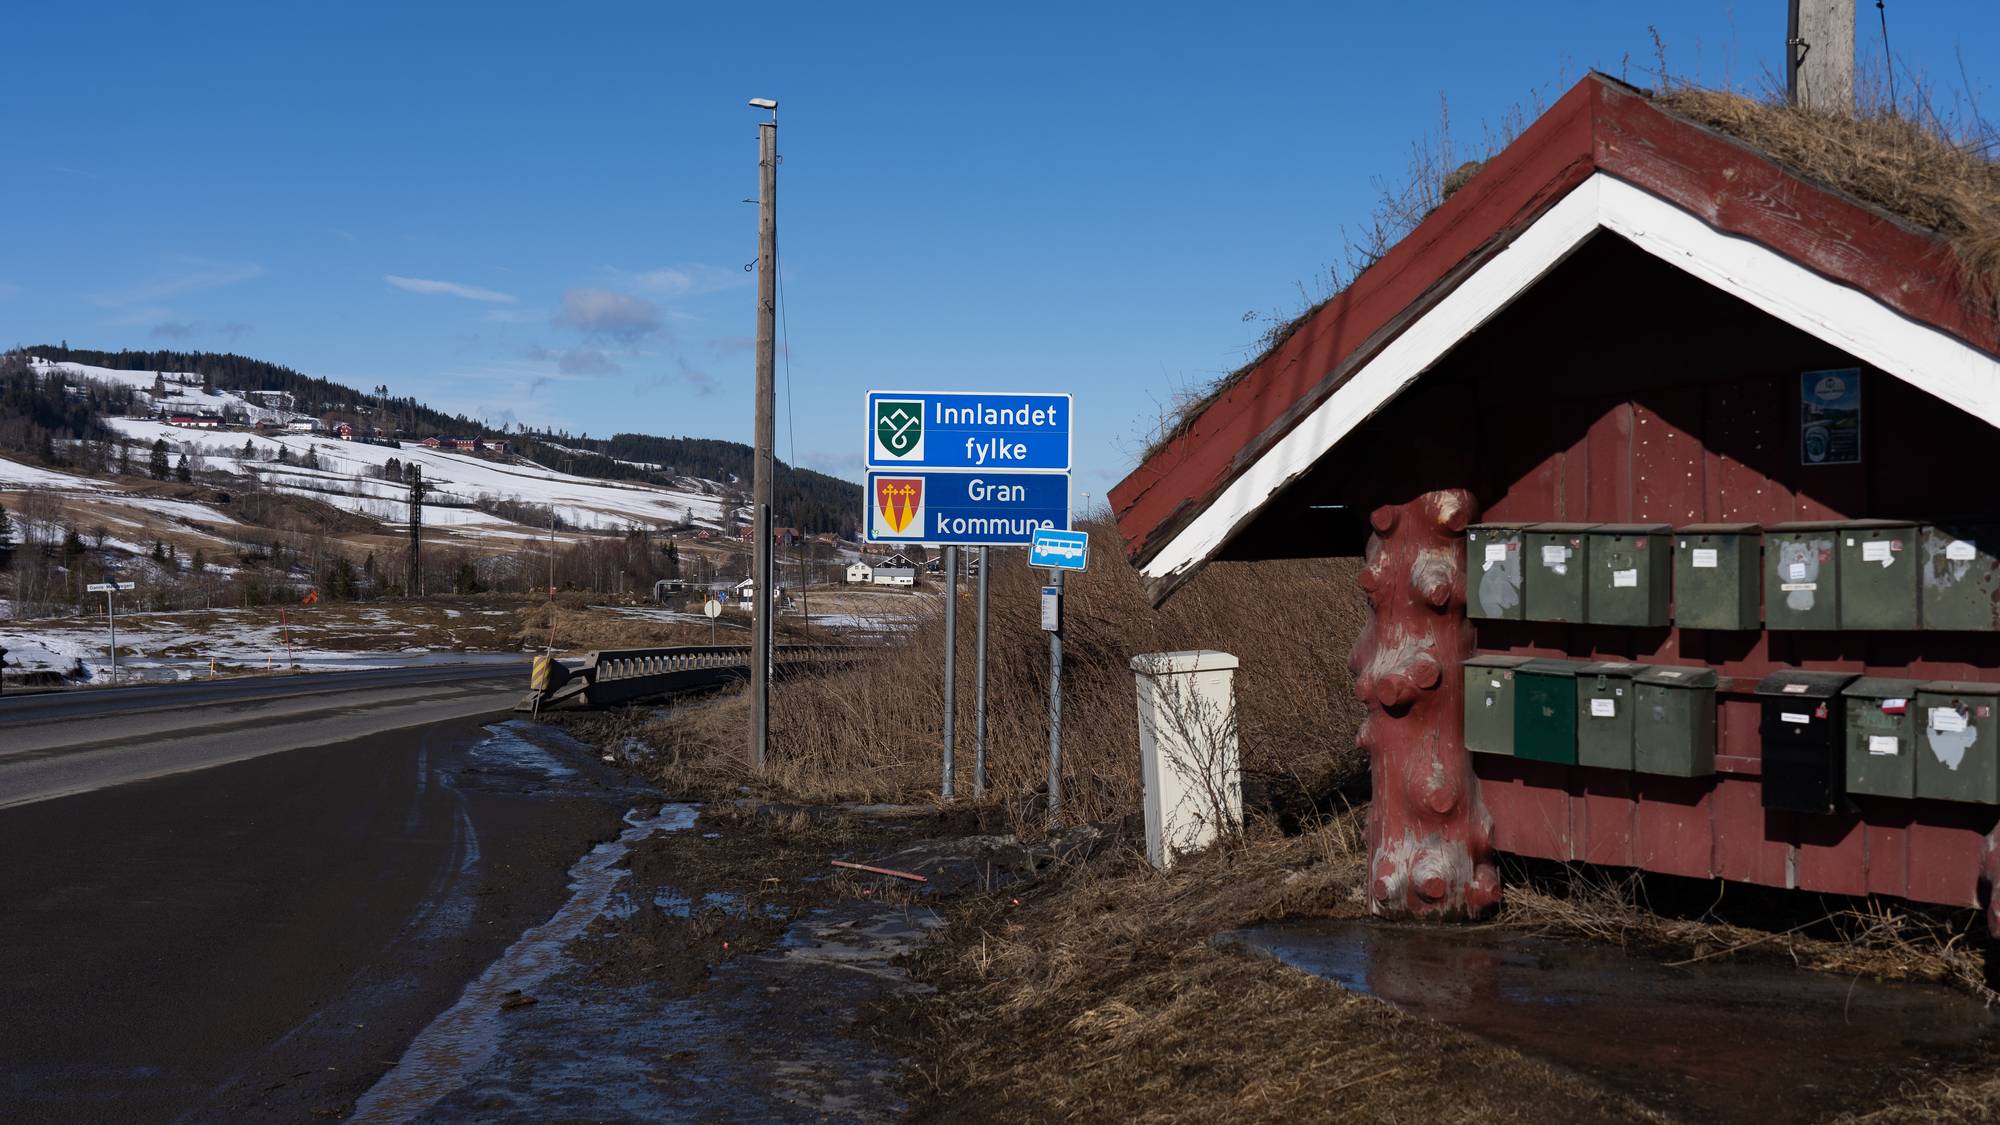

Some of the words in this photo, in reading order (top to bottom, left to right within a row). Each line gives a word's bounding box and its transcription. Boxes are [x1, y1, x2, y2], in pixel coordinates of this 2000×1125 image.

[936, 402, 1057, 426] Innlandet
[965, 437, 1027, 465] fylke
[968, 479, 1025, 501] Gran
